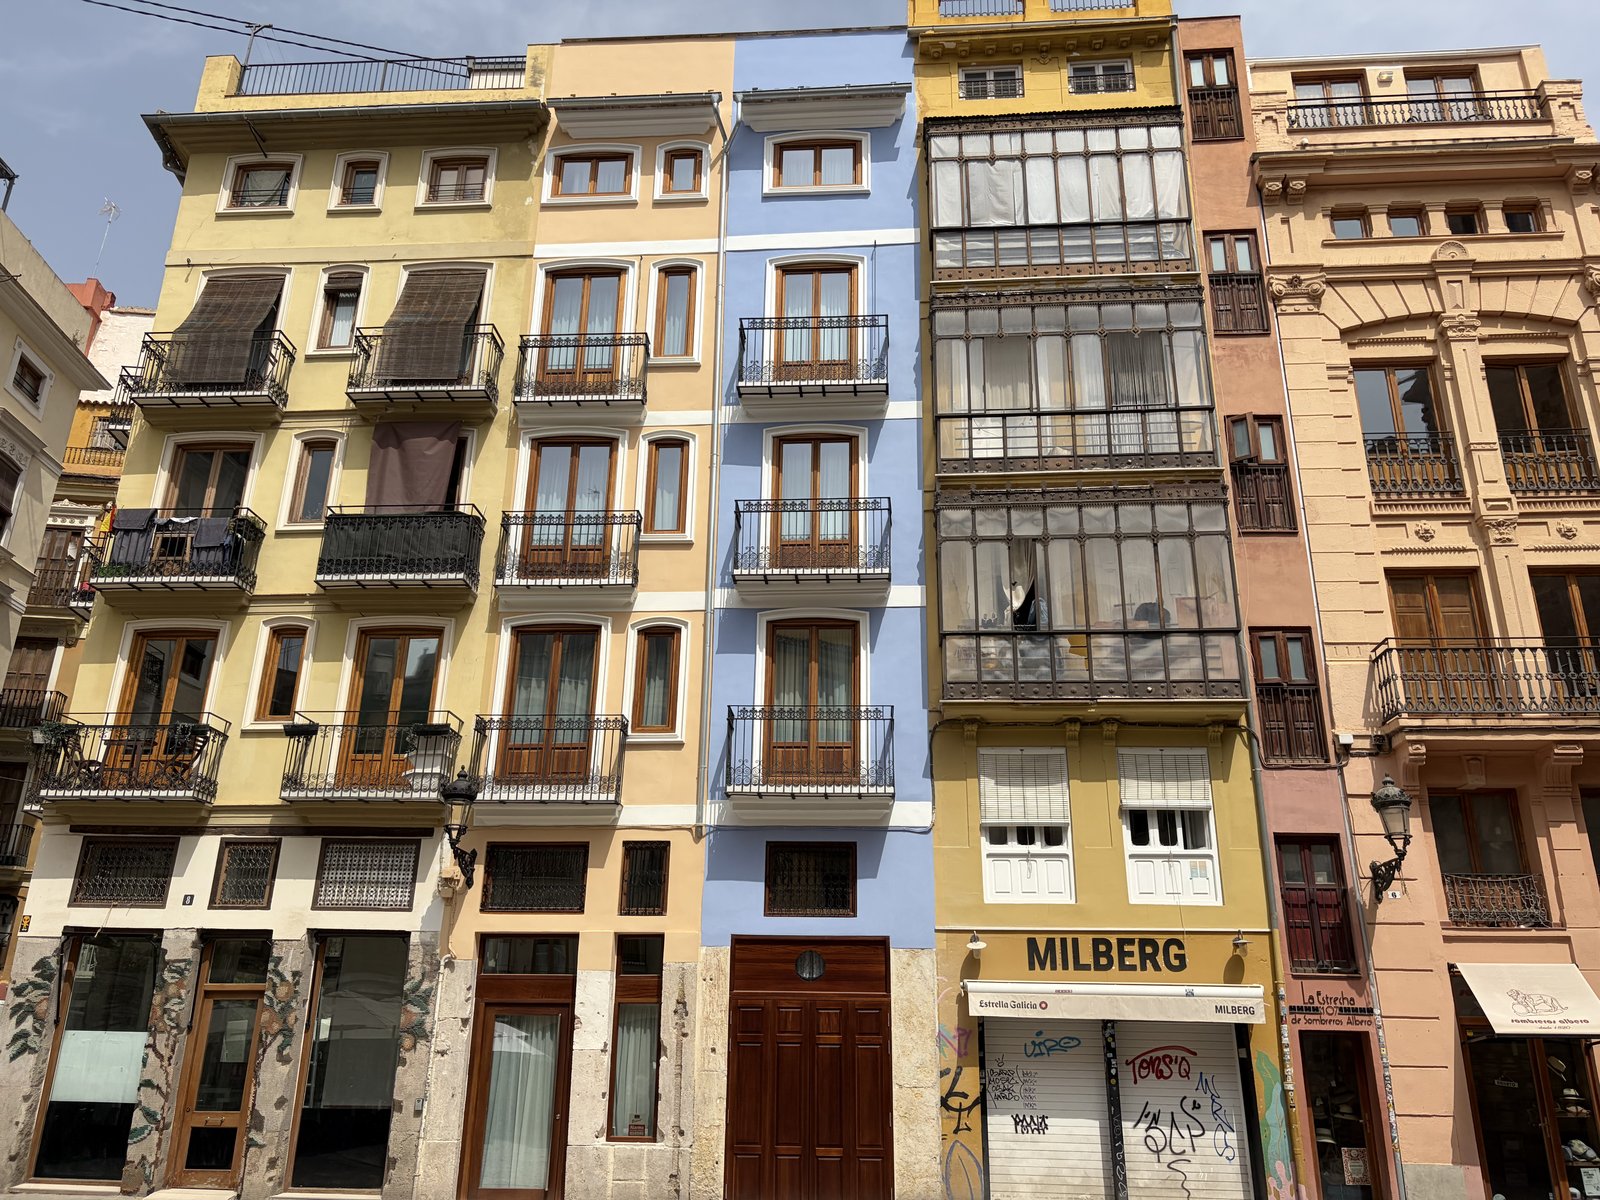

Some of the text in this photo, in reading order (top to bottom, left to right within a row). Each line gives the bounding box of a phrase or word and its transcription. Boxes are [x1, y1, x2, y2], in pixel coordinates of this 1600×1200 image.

[185, 895, 191, 904] 8
[1027, 937, 1187, 972] MILBERG
[1301, 981, 1356, 1006] La Estrecha
[979, 999, 1037, 1010] Estrella Galicia
[1214, 1005, 1255, 1015] MILBERG
[1291, 1015, 1373, 1026] de Sombreros Albero
